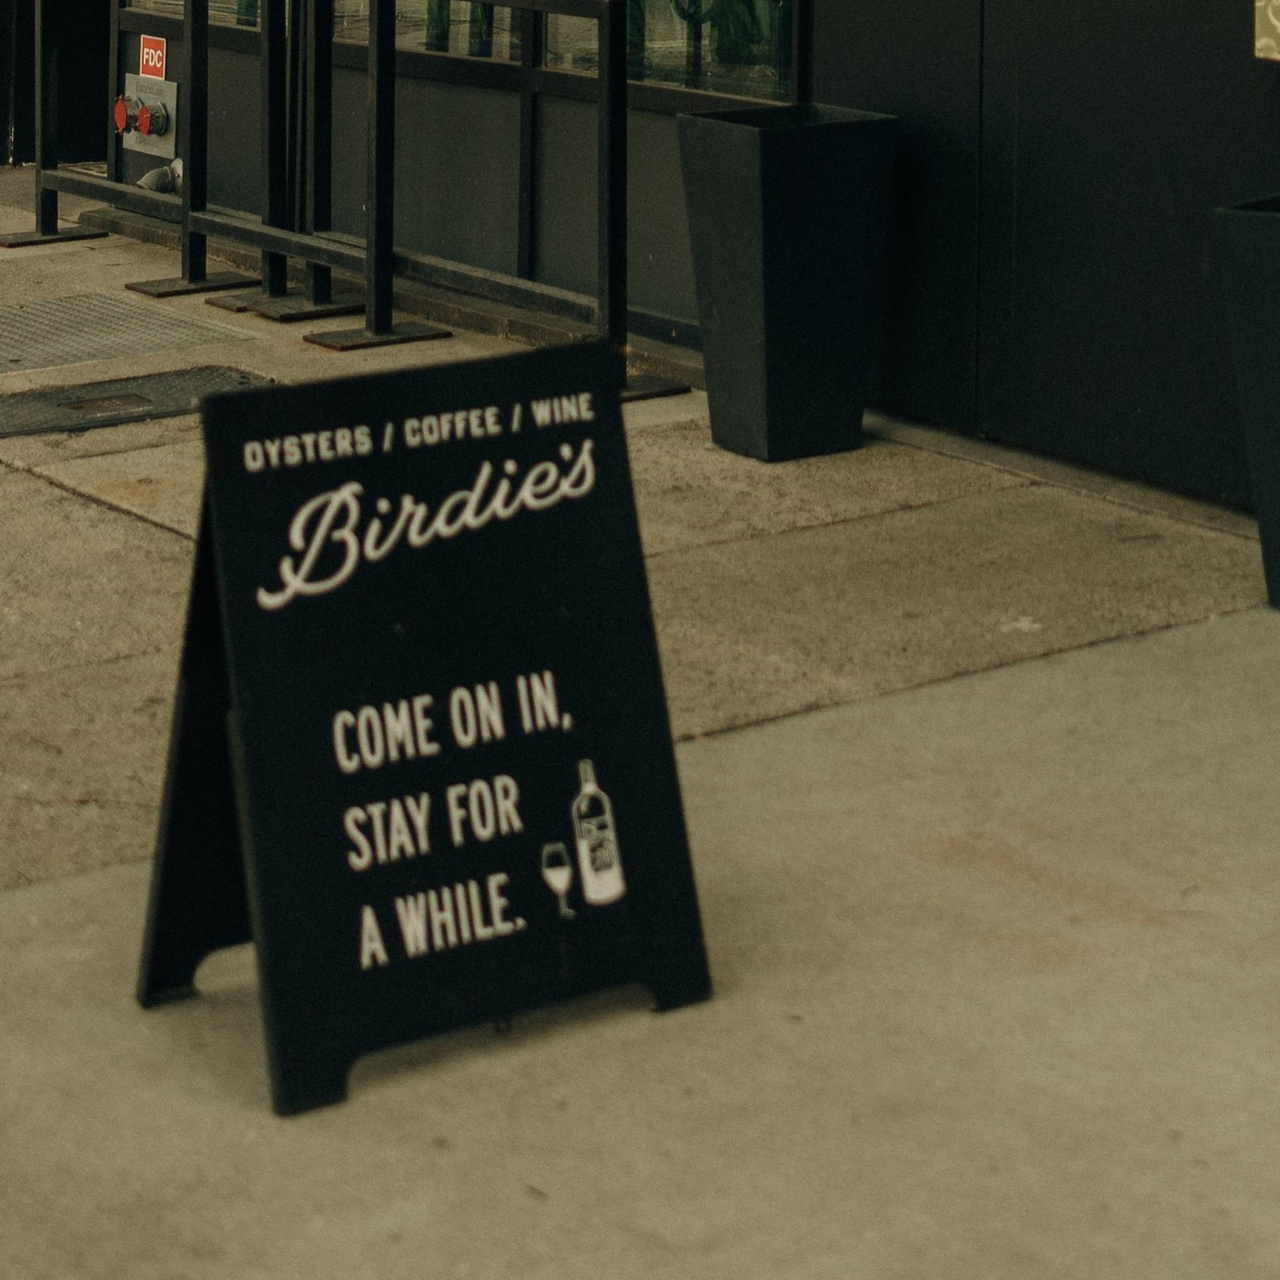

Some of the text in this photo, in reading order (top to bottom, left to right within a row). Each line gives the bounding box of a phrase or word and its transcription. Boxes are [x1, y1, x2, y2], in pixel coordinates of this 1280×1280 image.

[143, 47, 162, 68] FDC
[243, 425, 373, 473] OYSTERS
[404, 406, 502, 447] COFFEE
[531, 393, 595, 427] WINE
[256, 438, 596, 611] Birdie's
[332, 669, 573, 774] COME ON IN,
[344, 791, 431, 872] STAY
[446, 773, 524, 848] FOR
[360, 872, 528, 972] A WHILE.
